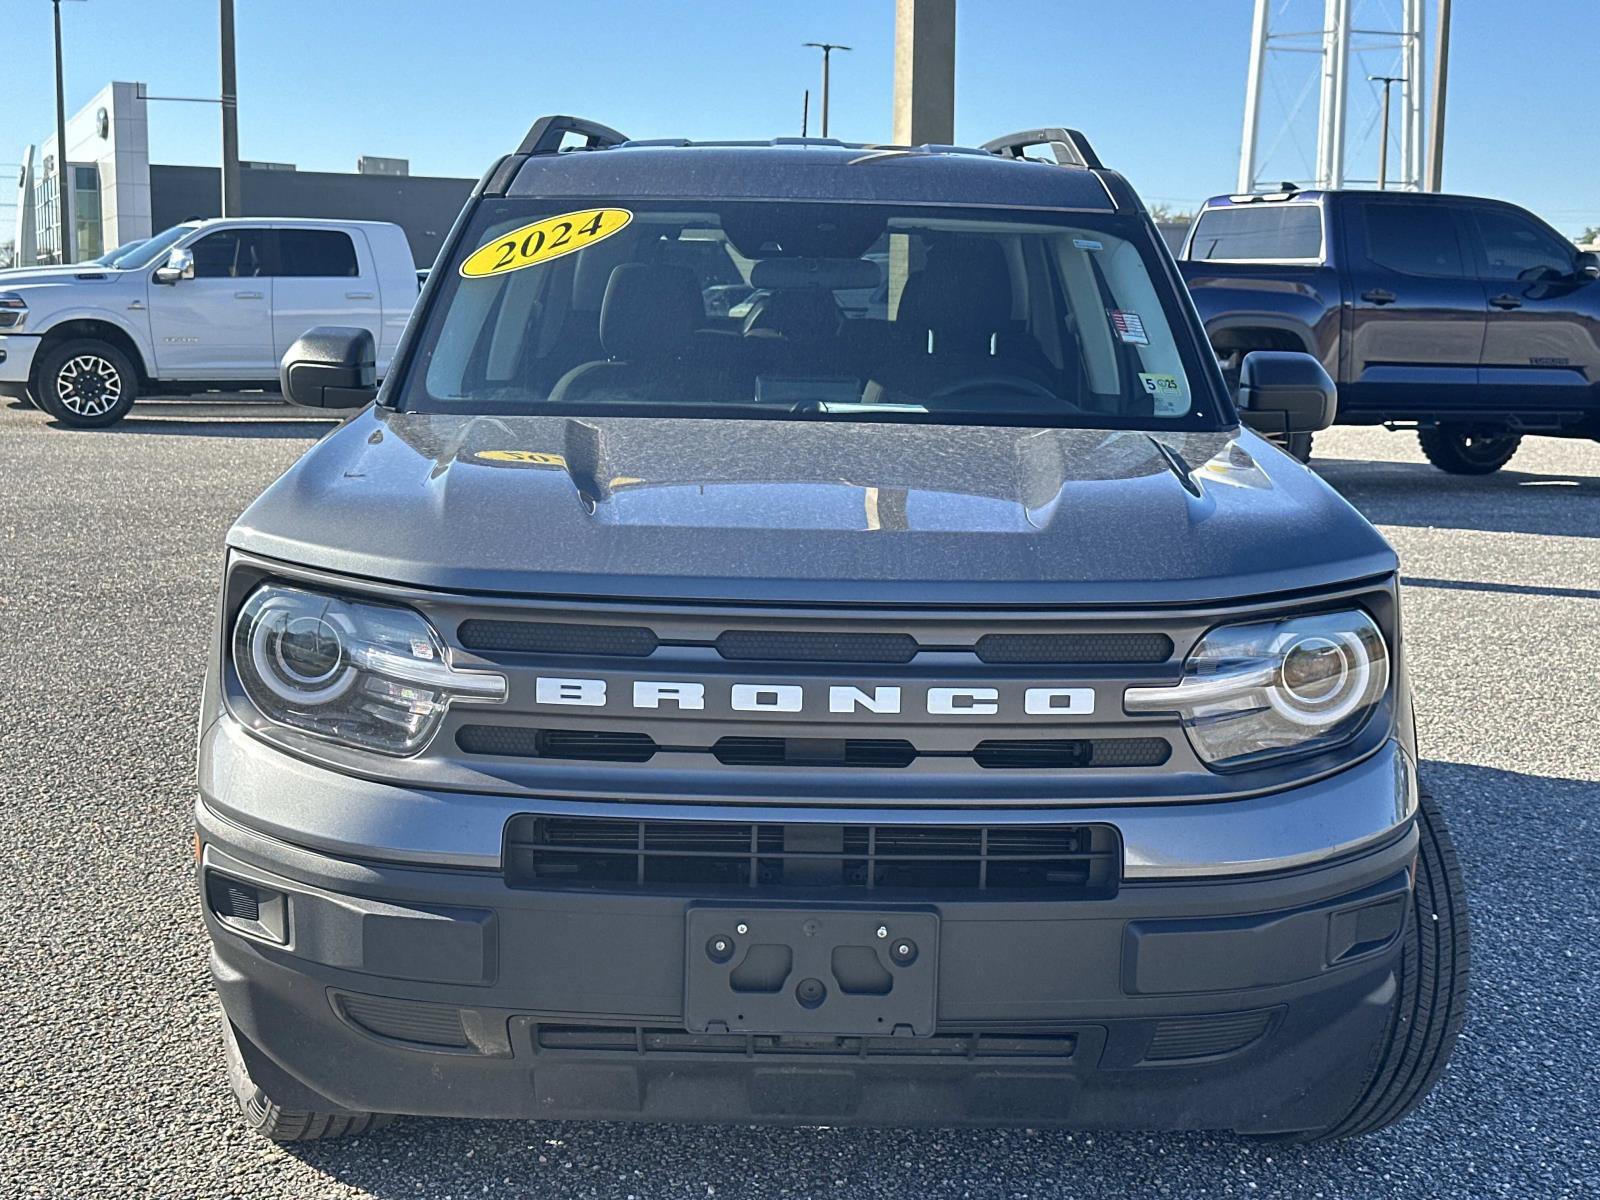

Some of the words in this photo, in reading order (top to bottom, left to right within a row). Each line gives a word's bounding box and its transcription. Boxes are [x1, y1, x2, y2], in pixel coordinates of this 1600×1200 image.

[492, 211, 604, 271] 2024
[1145, 378, 1157, 391] 5
[535, 676, 1096, 715] BRONCO
